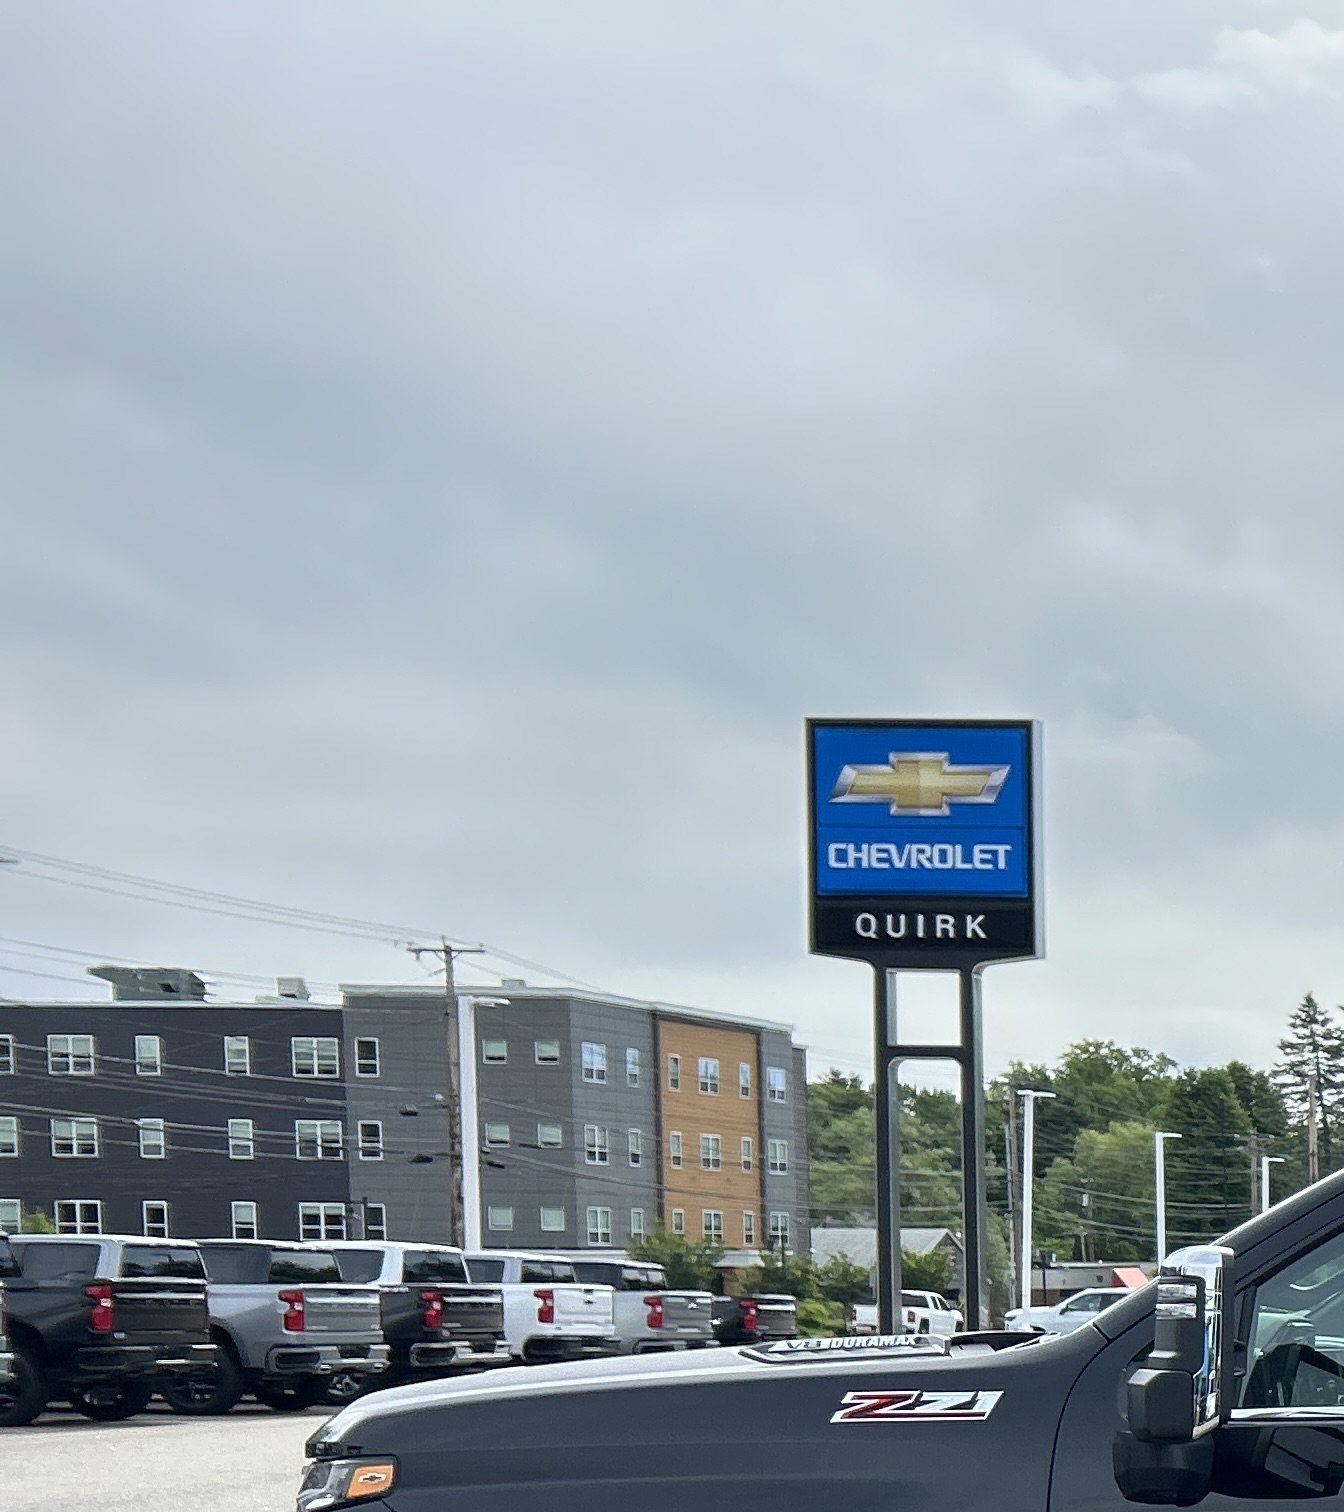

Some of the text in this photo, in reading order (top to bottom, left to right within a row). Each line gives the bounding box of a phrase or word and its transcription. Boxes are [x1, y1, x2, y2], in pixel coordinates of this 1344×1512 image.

[827, 842, 1012, 870] CHEVROLET
[855, 912, 988, 939] QUIRK
[830, 1335, 917, 1349] DURAMAX
[830, 1389, 1005, 1424] Z71
